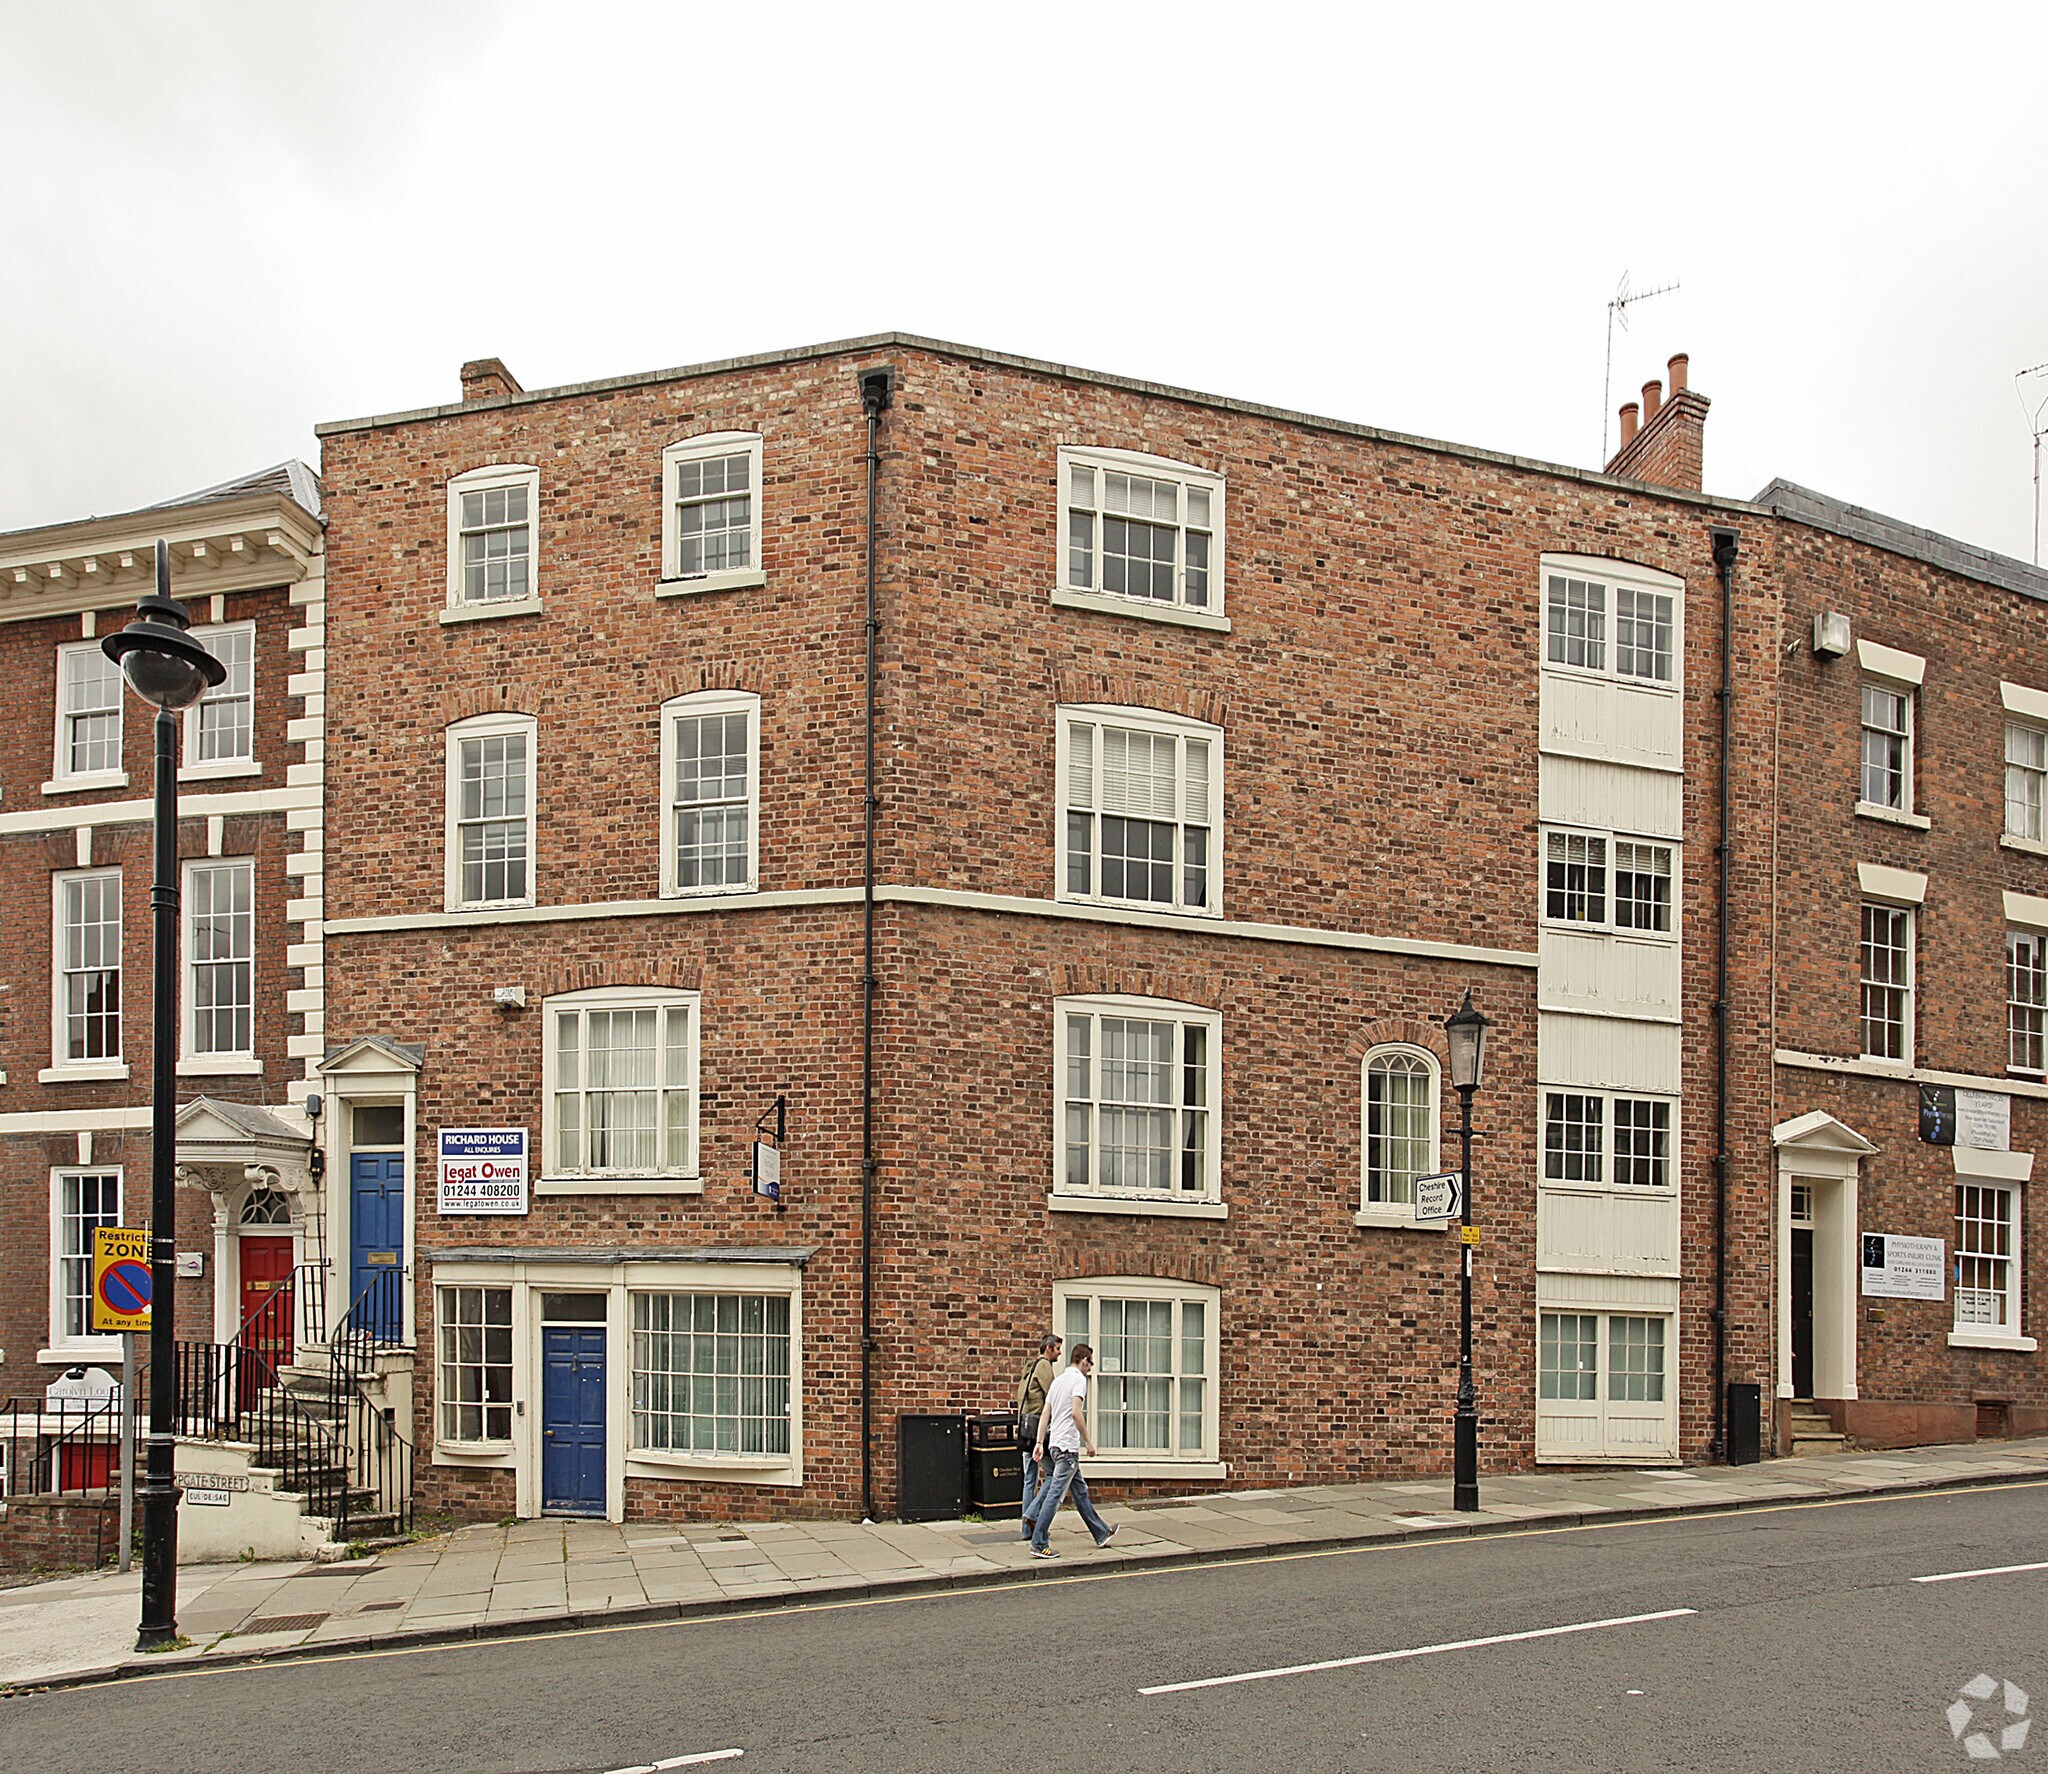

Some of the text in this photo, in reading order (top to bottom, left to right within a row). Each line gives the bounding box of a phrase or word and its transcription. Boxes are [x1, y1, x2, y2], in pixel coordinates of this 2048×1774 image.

[445, 1134, 520, 1145] RICHARD HOUSE
[444, 1162, 520, 1184] Legat Owen
[443, 1185, 520, 1197] 01244 408200
[1419, 1181, 1445, 1192] Cheshire
[444, 1200, 520, 1208] www.legatowen.co.uk
[1421, 1194, 1443, 1204] Record
[1422, 1206, 1442, 1215] Office
[99, 1230, 151, 1243] Restrict
[1891, 1241, 1933, 1251] PHYSIOTHERAPY
[1886, 1251, 1907, 1259] SPORTS
[116, 1319, 132, 1327] any
[49, 1386, 86, 1398] Carolyn
[209, 1476, 244, 1490] STREET
